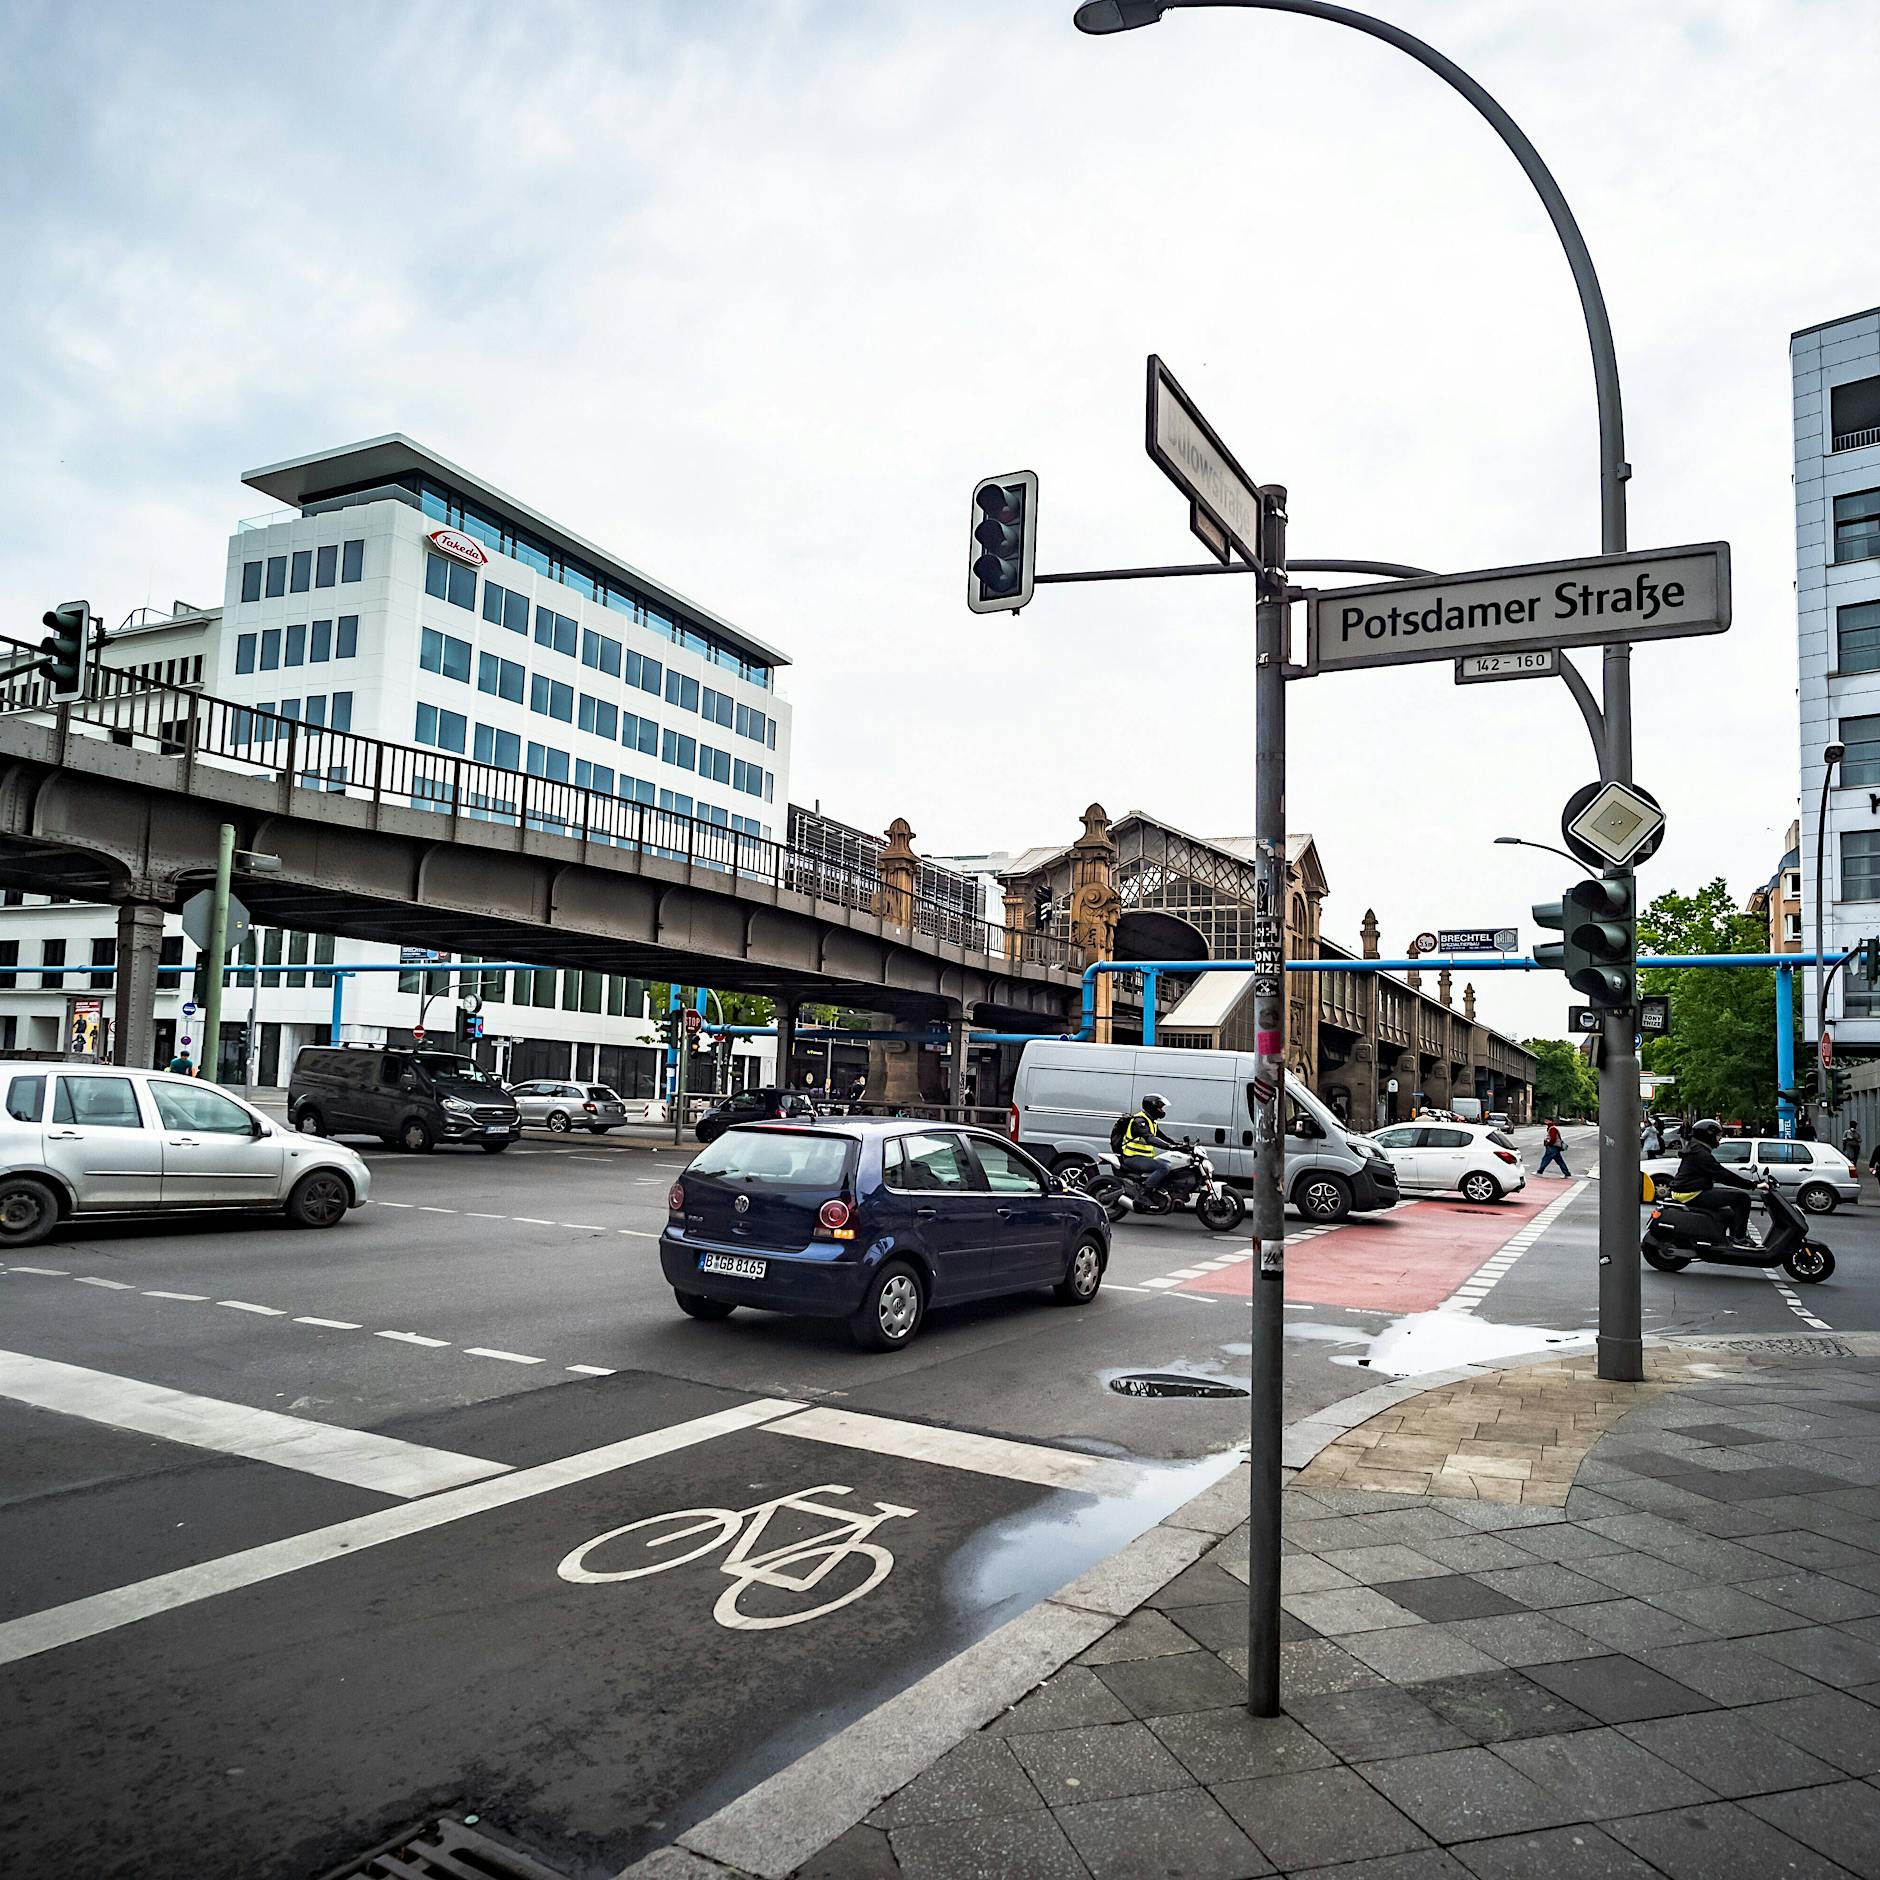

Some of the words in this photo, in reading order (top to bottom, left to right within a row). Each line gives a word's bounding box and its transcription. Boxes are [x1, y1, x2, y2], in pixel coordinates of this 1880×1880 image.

[441, 535, 479, 560] Takeda
[1341, 596, 1541, 642] Potsdamer
[1554, 573, 1685, 620] Straße
[1441, 934, 1492, 942] BRECHTEL
[1254, 951, 1280, 961] ONY
[1254, 963, 1280, 974] HIZE
[705, 1254, 714, 1268] B
[719, 1256, 735, 1271] GB
[735, 1259, 765, 1275] 8165
